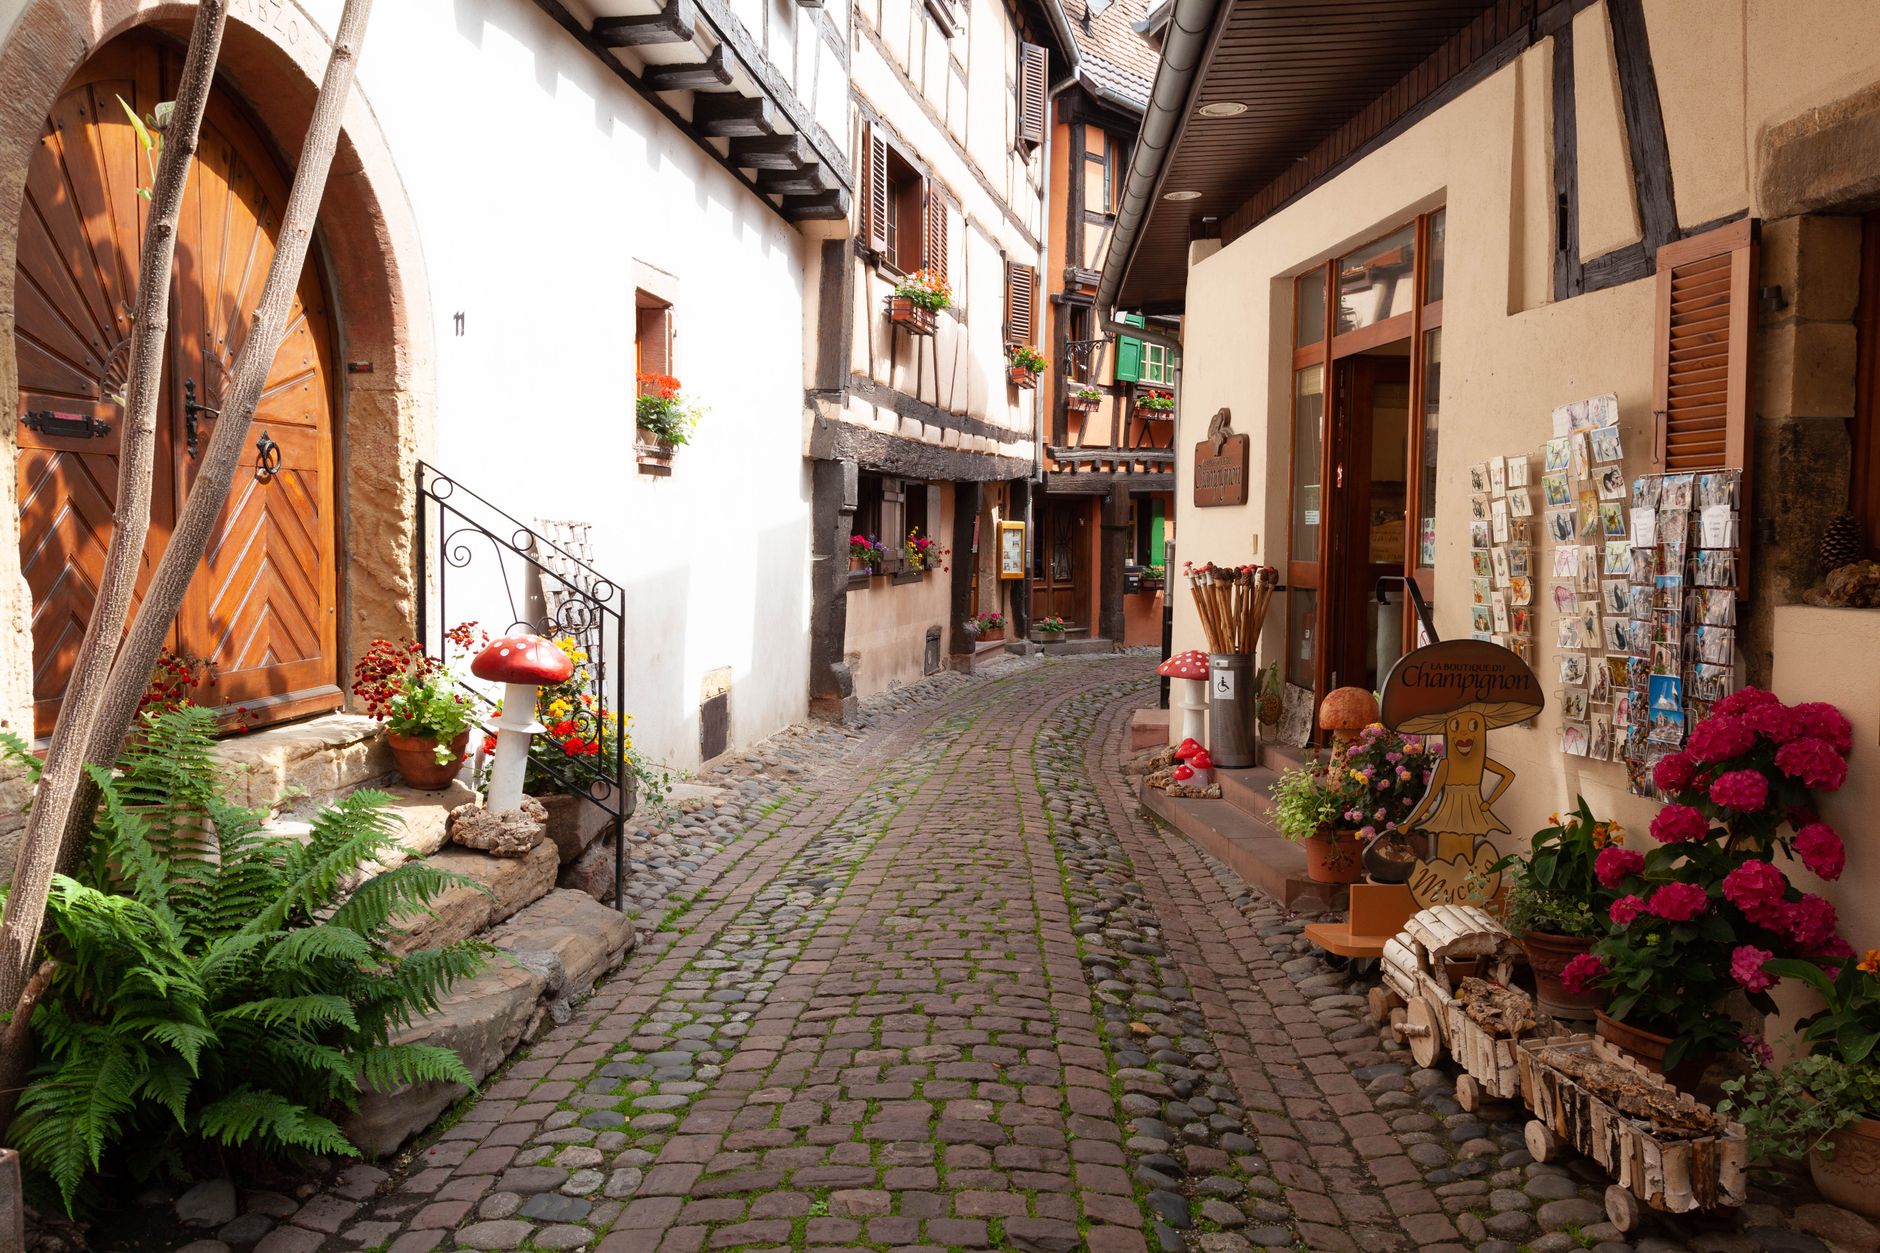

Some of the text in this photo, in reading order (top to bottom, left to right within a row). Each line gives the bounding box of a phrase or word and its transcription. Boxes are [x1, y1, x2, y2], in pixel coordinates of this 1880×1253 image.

[453, 311, 465, 337] 11
[1401, 661, 1530, 700] Champignon
[1430, 663, 1505, 672] LA BOUTIQUE DU
